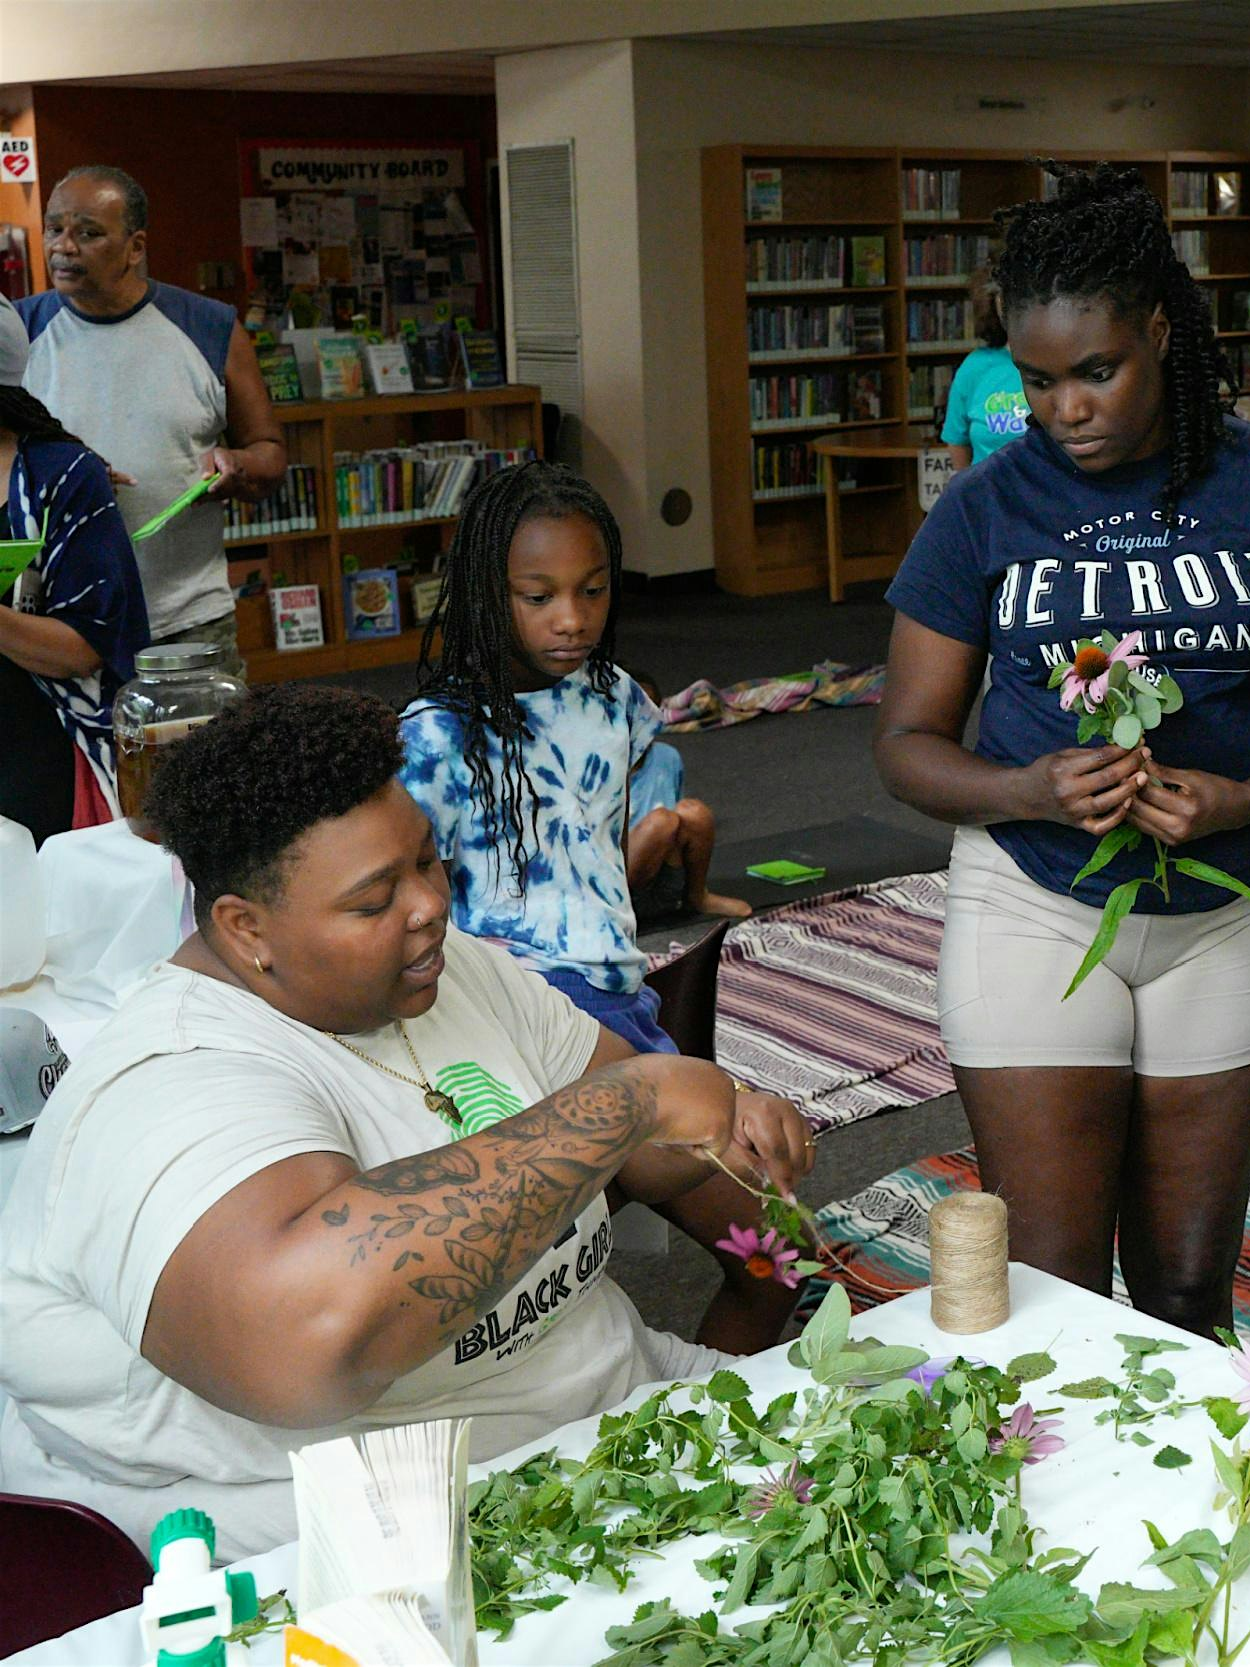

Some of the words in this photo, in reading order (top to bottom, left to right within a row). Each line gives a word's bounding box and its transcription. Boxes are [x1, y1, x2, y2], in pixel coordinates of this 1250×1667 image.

[2, 141, 29, 152] AED
[271, 160, 380, 184] COMMUNITY
[385, 159, 449, 179] BOARD
[1063, 511, 1135, 541] MOTOR
[1151, 510, 1200, 528] CTY
[1095, 528, 1171, 554] Original
[454, 1264, 572, 1365] BLACK
